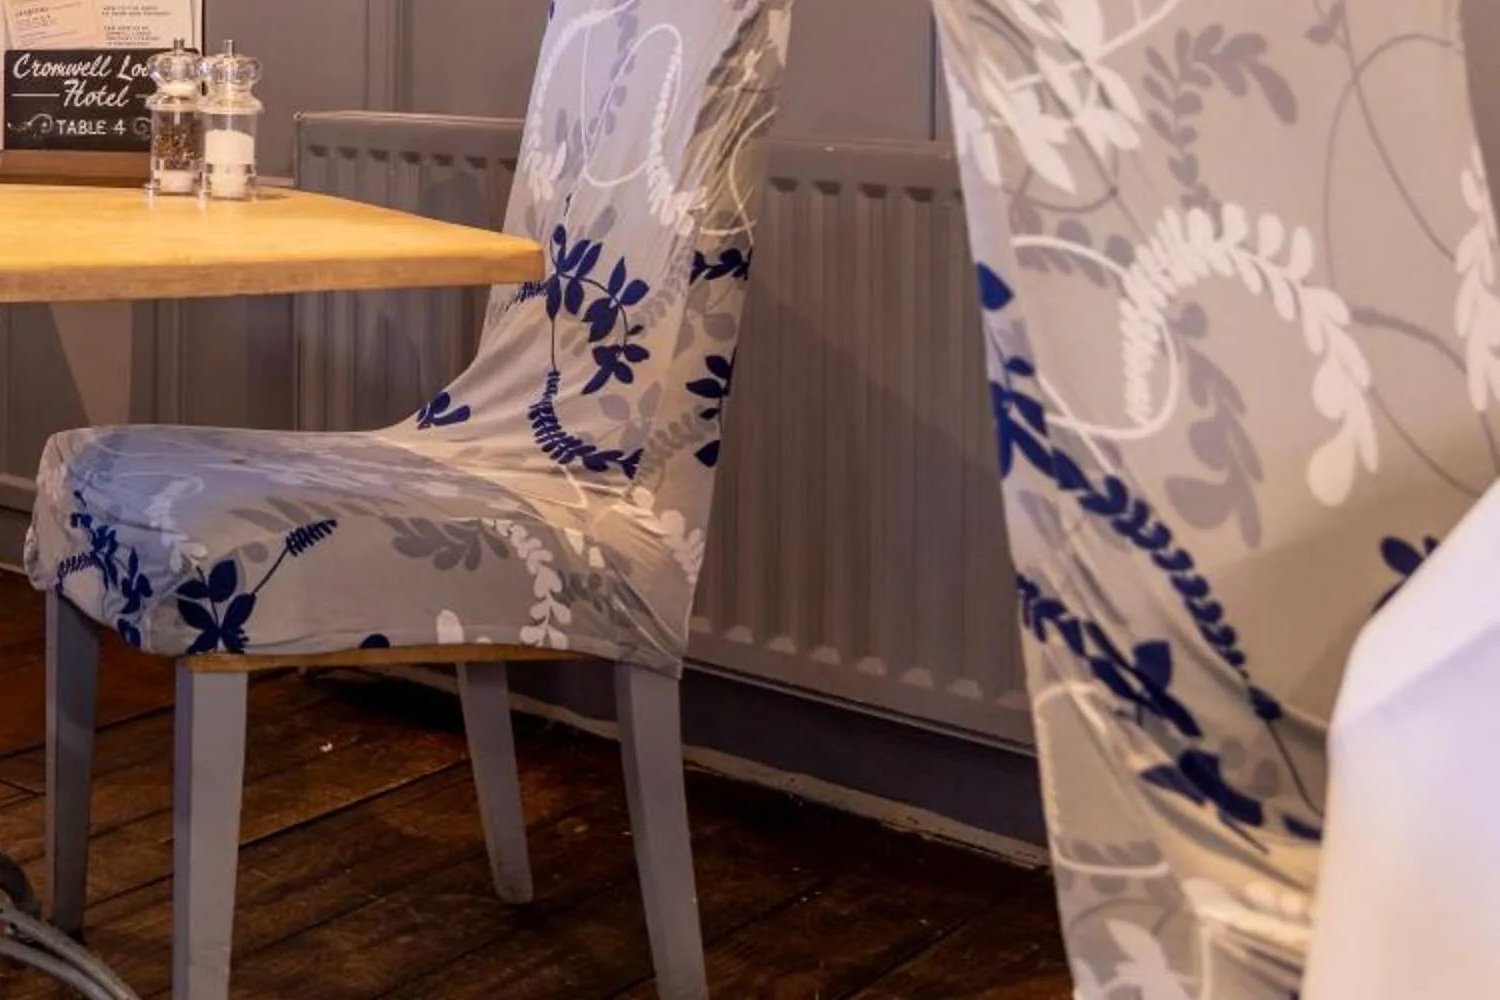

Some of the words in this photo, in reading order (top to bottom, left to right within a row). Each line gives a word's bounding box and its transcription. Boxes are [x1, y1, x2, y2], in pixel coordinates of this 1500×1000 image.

[13, 53, 113, 80] Cromwell
[63, 79, 130, 107] Hotel
[56, 119, 108, 135] TABLE
[113, 119, 127, 136] 4
